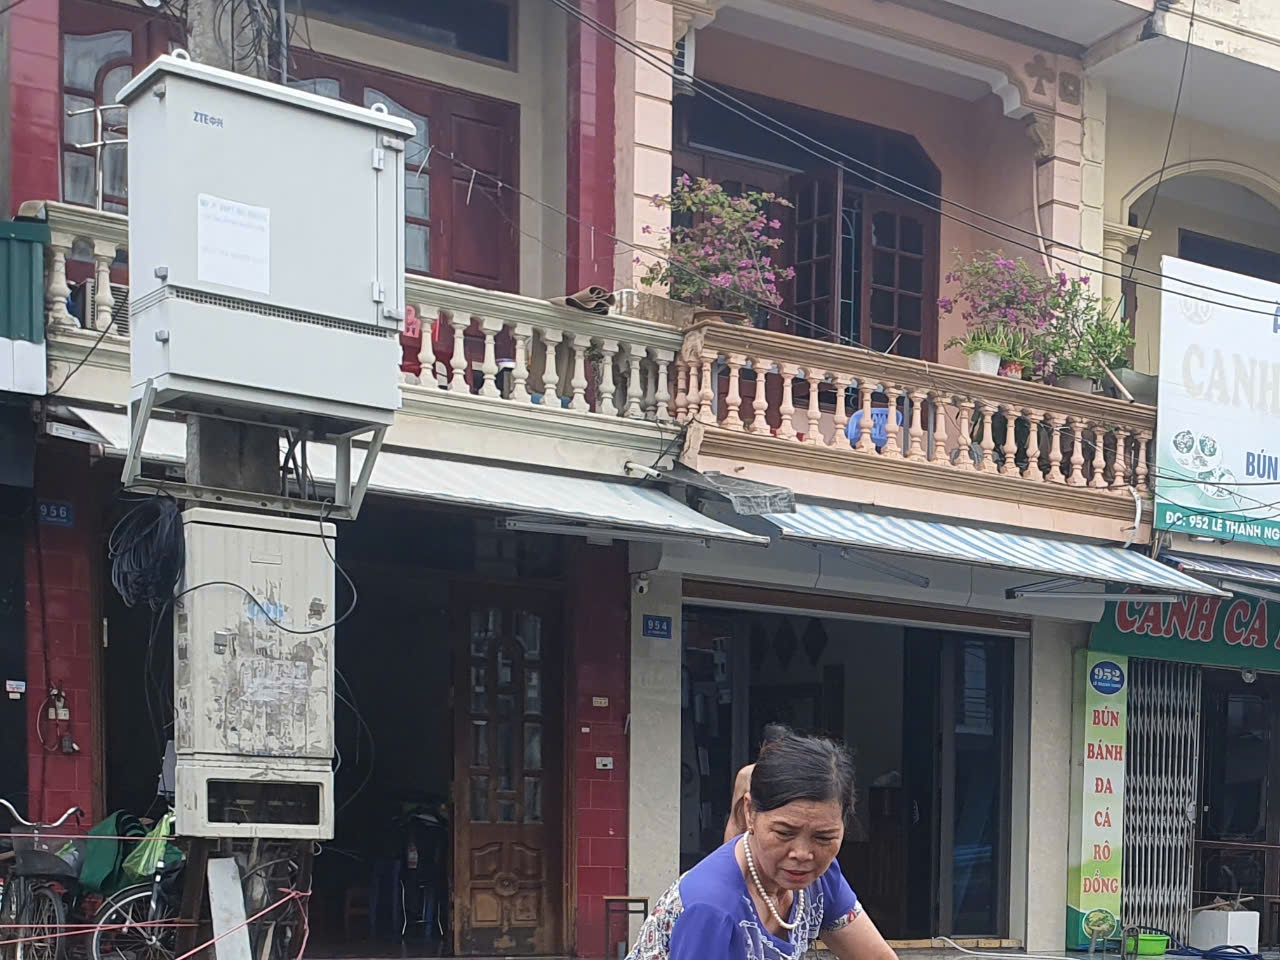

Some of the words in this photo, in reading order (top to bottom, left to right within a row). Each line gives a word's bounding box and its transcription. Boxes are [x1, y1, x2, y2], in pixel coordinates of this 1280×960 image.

[1246, 448, 1279, 481] BÚN
[40, 504, 67, 518] 956
[1189, 515, 1209, 530] 952
[1225, 520, 1262, 538] THANH
[647, 619, 667, 631] 954
[1116, 587, 1222, 642] CANH
[1094, 667, 1121, 682] 952
[1092, 705, 1120, 727] BÚN
[1087, 739, 1123, 762] BÁNH
[1094, 777, 1114, 795] ĐA
[1094, 807, 1112, 828] CÁ
[1093, 839, 1112, 860] RÔ
[1083, 867, 1119, 894] ĐỒNG
